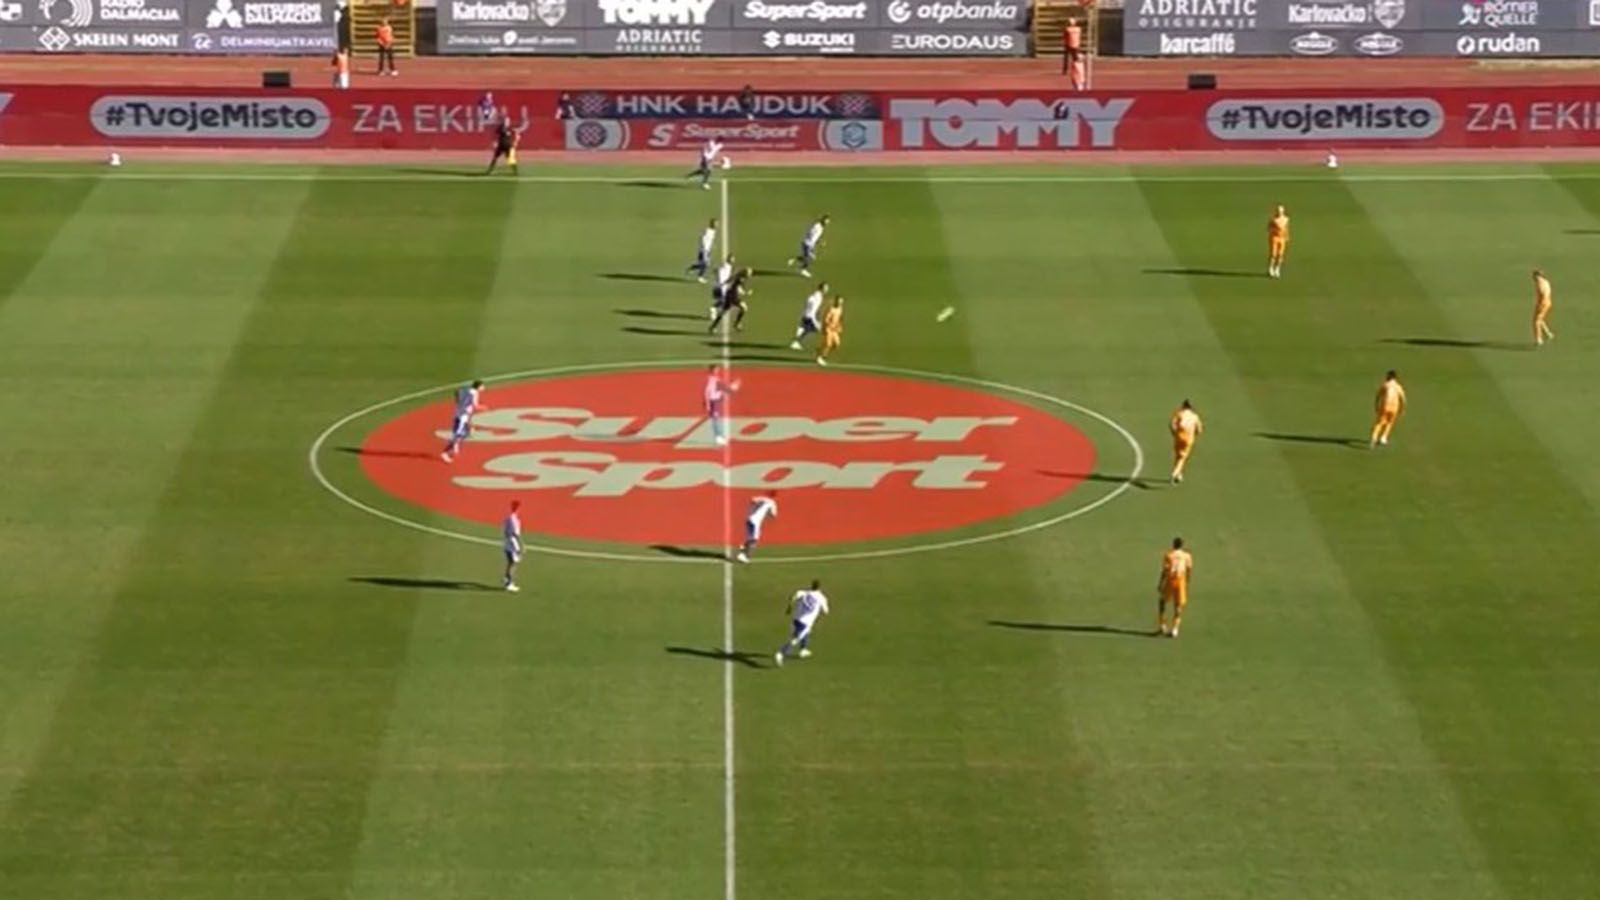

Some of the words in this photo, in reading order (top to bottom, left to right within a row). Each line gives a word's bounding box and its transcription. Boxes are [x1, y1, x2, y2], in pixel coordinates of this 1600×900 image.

[100, 8, 180, 20] DALMACIJA
[598, 0, 716, 24] TOMMY
[744, 2, 867, 21] SuperSport
[917, 2, 1018, 23] otpbanka
[1139, 0, 1257, 16] ADRIATIC
[132, 33, 179, 47] MONT
[616, 29, 703, 43] ADRIATIC
[784, 33, 855, 46] SUZUKI
[891, 34, 1014, 49] EURODAUS
[1478, 33, 1540, 52] rudan
[616, 95, 686, 114] HNK
[105, 102, 318, 131] #TvojeMisto
[353, 104, 403, 132] ZA
[890, 98, 1136, 147] TOMMY
[1221, 104, 1431, 134] #TvojeMisto
[1466, 103, 1518, 131] ZA
[1531, 102, 1600, 130] EKI
[435, 407, 1017, 448] Super
[452, 451, 1004, 496] Sport
